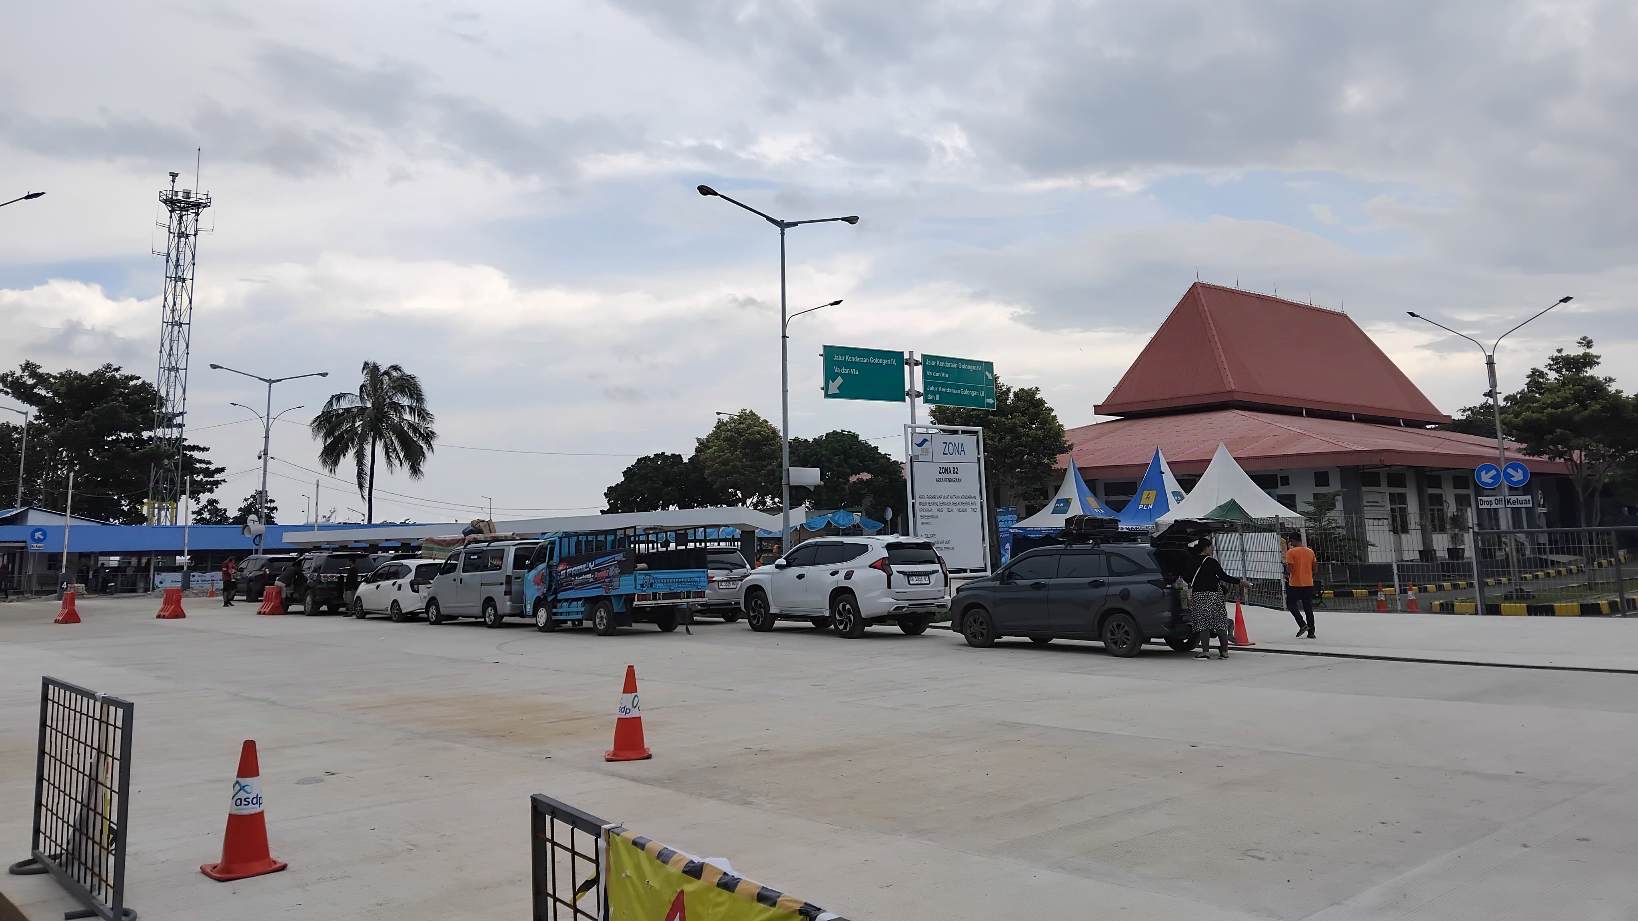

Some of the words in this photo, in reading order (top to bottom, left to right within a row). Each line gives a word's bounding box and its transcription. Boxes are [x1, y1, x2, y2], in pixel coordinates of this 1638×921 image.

[942, 441, 966, 456] ZONA
[938, 466, 952, 475] ZONA
[1479, 498, 1493, 507] Drop
[1494, 497, 1504, 506] Off
[1506, 497, 1531, 506] Keluar
[234, 793, 262, 808] asdp
